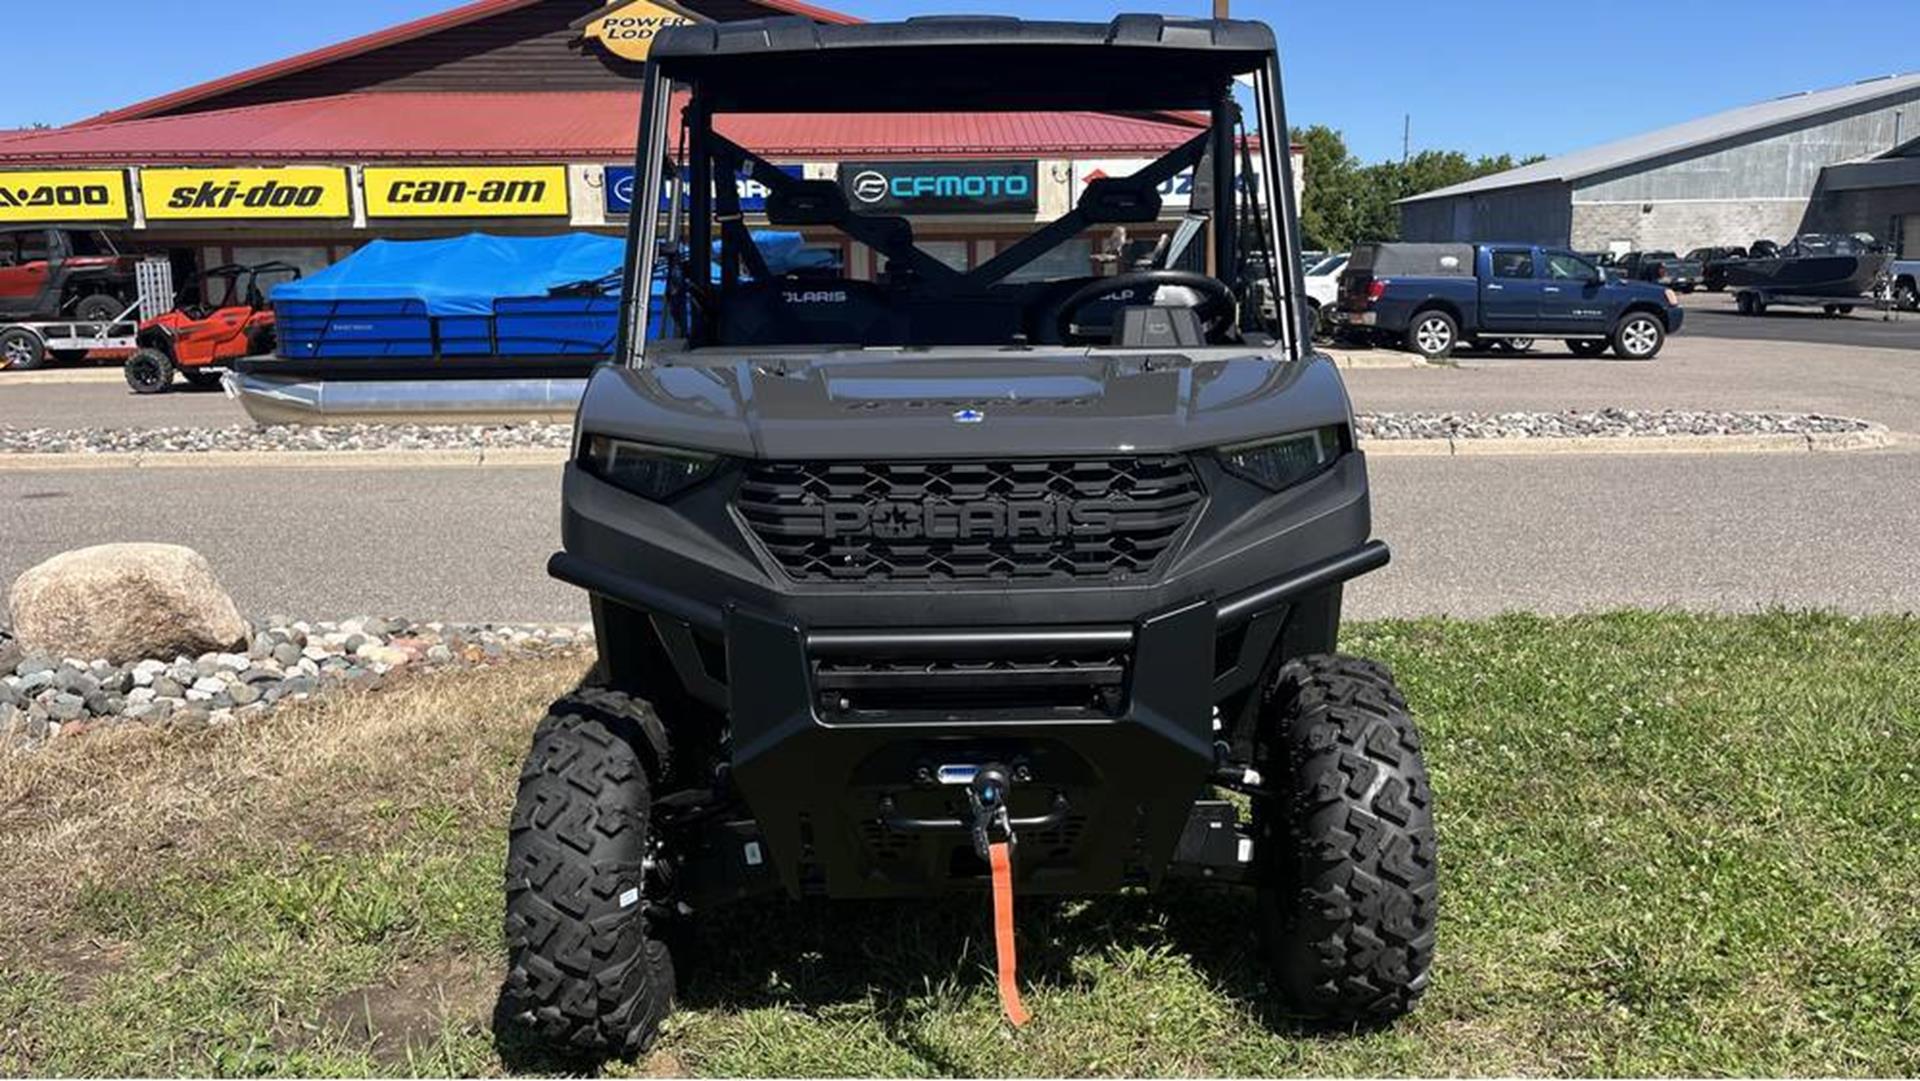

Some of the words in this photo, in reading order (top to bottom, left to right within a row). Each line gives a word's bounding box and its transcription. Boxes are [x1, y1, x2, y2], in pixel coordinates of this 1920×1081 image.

[602, 17, 686, 29] POWER
[607, 28, 654, 39] LOD
[168, 180, 324, 208] ski-doo
[387, 180, 547, 203] can-am
[890, 175, 1028, 197] CFMOTO
[823, 501, 1117, 538] POLARIS
